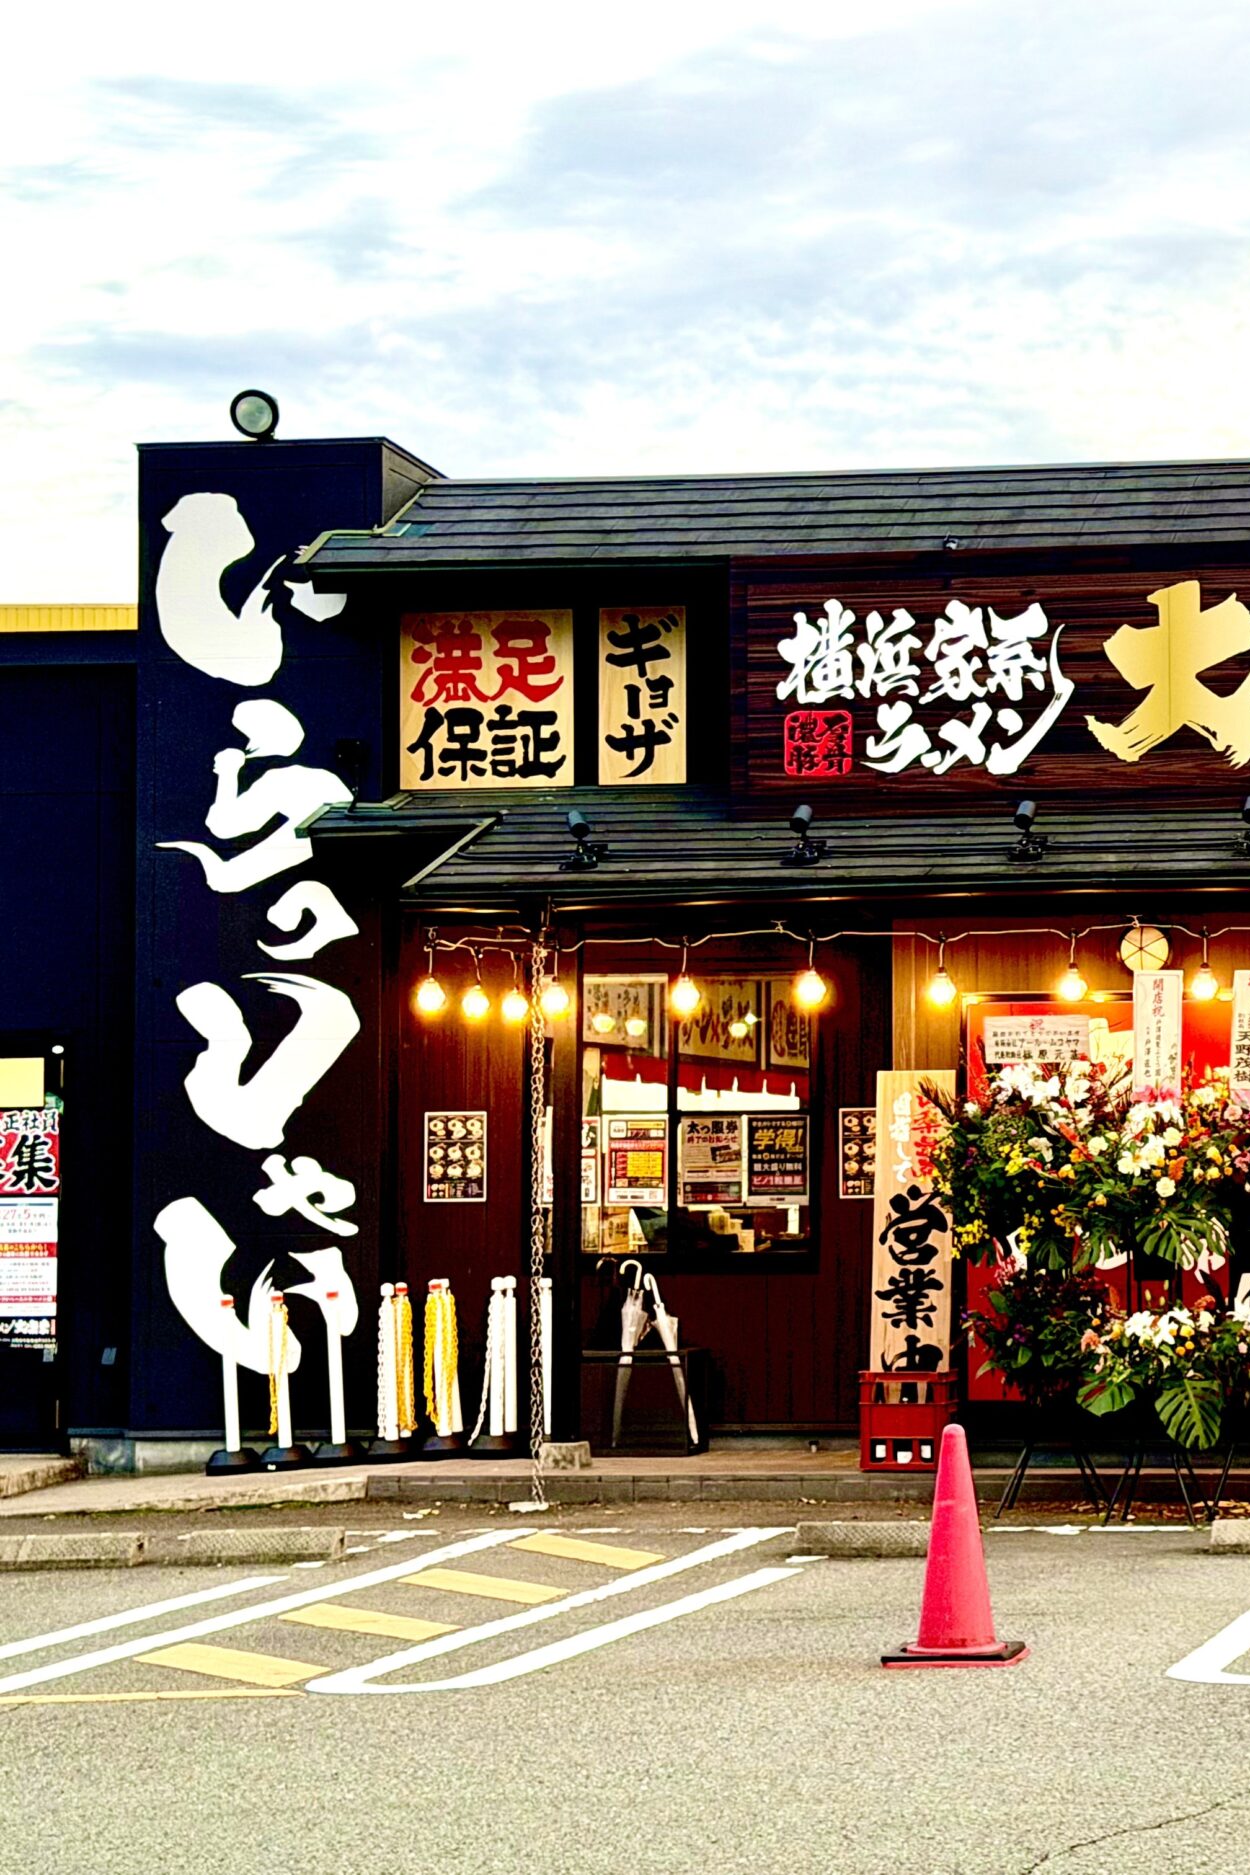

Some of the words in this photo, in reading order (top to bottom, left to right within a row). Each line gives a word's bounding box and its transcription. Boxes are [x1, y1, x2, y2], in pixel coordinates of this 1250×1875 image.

[409, 619, 565, 707] 満足
[776, 599, 1048, 704] 横浜家系
[860, 624, 1075, 775] ラーメン
[406, 704, 567, 782] 保証
[155, 491, 361, 1375] いらっしゃい
